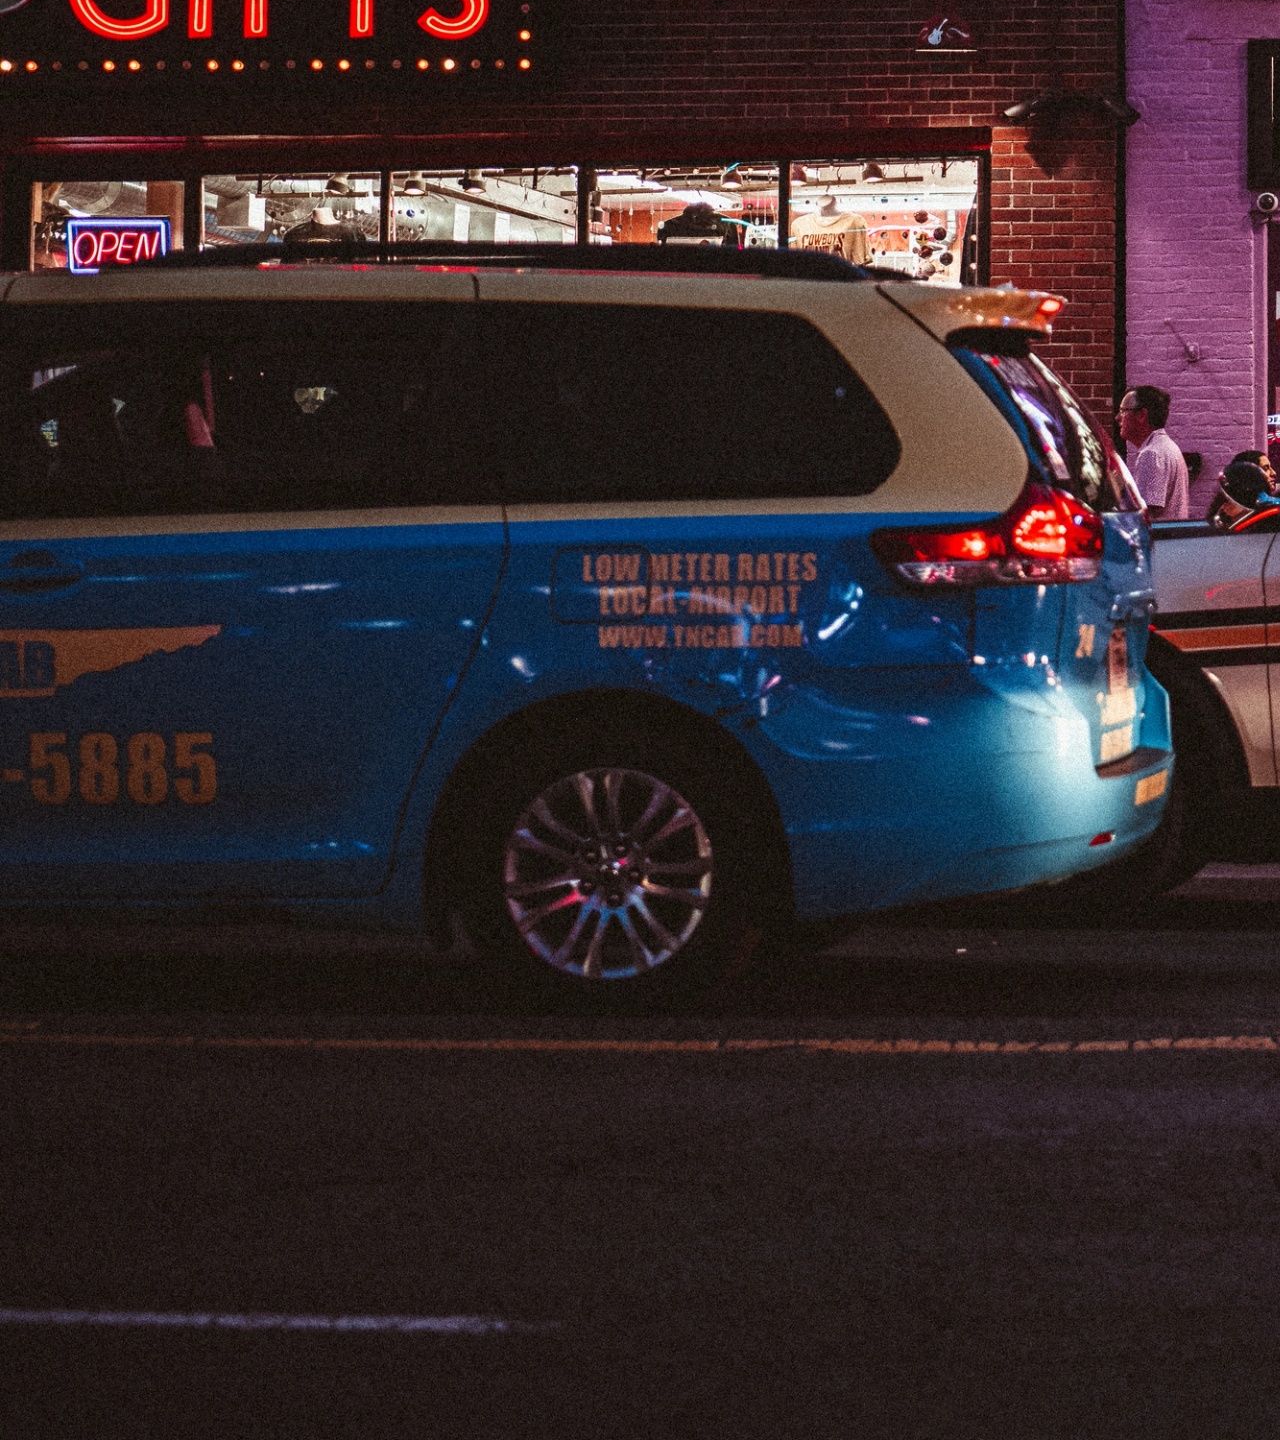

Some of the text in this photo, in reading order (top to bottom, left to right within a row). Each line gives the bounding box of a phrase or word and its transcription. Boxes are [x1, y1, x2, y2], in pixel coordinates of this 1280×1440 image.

[73, 231, 160, 265] OPEN
[582, 552, 818, 582] LOW METER RATES
